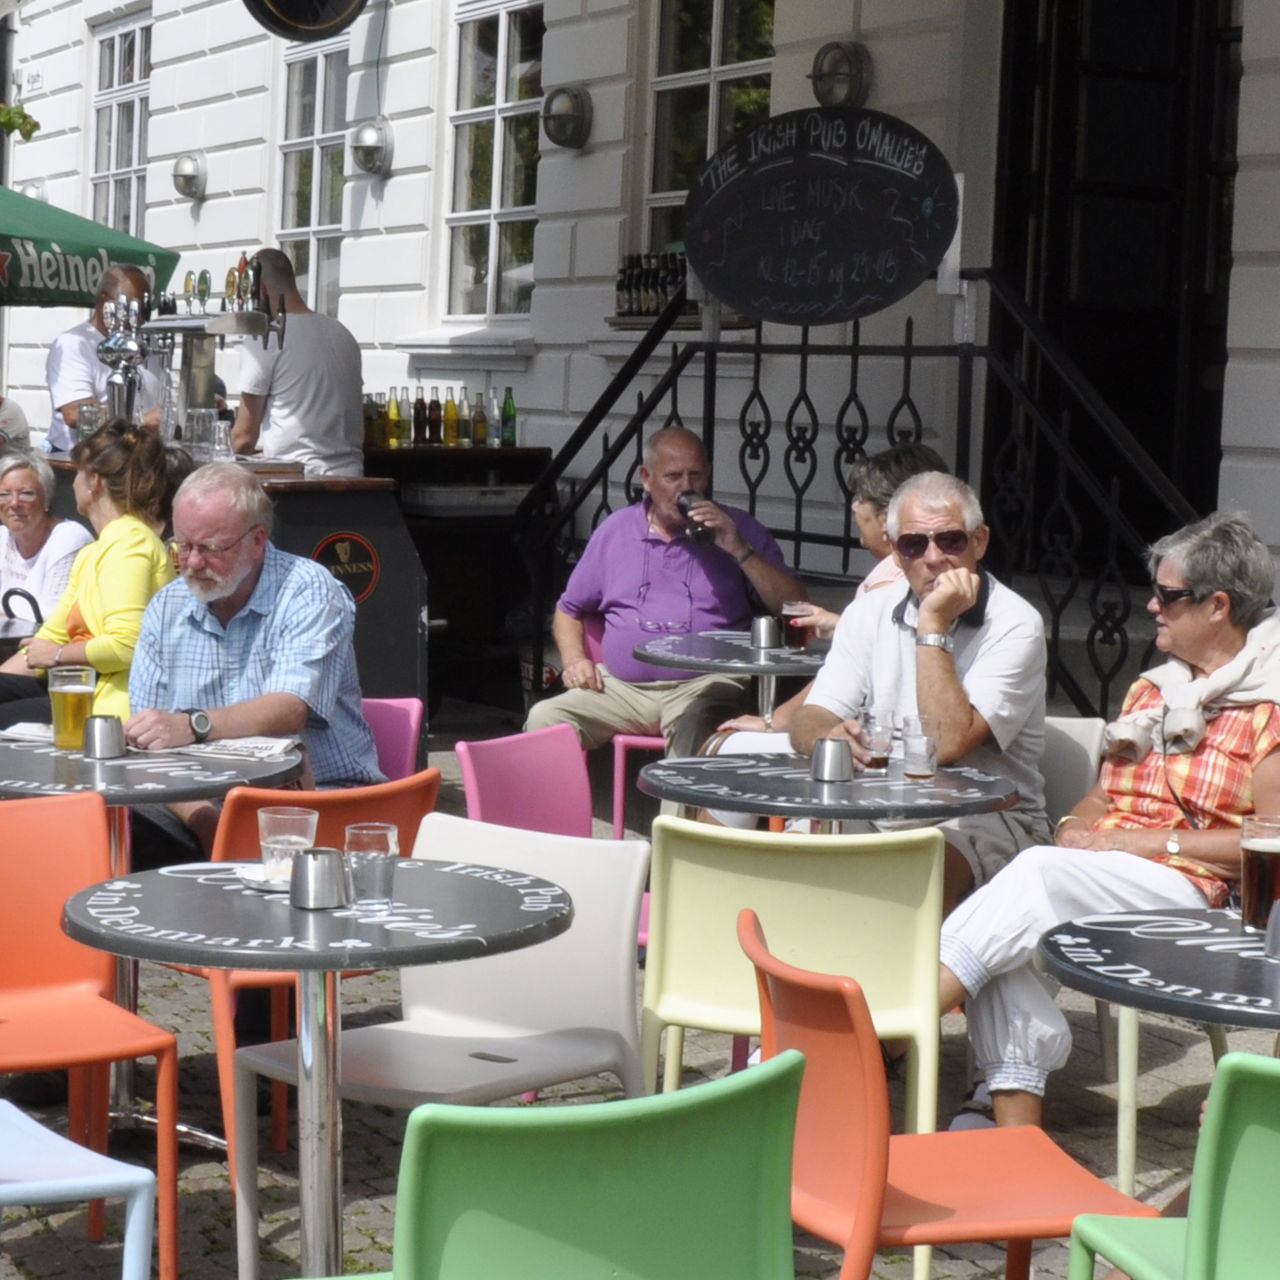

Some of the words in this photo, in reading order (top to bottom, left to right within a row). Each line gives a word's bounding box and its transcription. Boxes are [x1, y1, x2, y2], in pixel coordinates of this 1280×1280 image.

[804, 113, 847, 148] PUB
[11, 238, 157, 300] Heine
[329, 562, 374, 576] INNESS
[434, 861, 537, 887] Irish
[518, 886, 567, 912] Pub
[87, 906, 316, 949] Denmark
[1060, 946, 1113, 963] in
